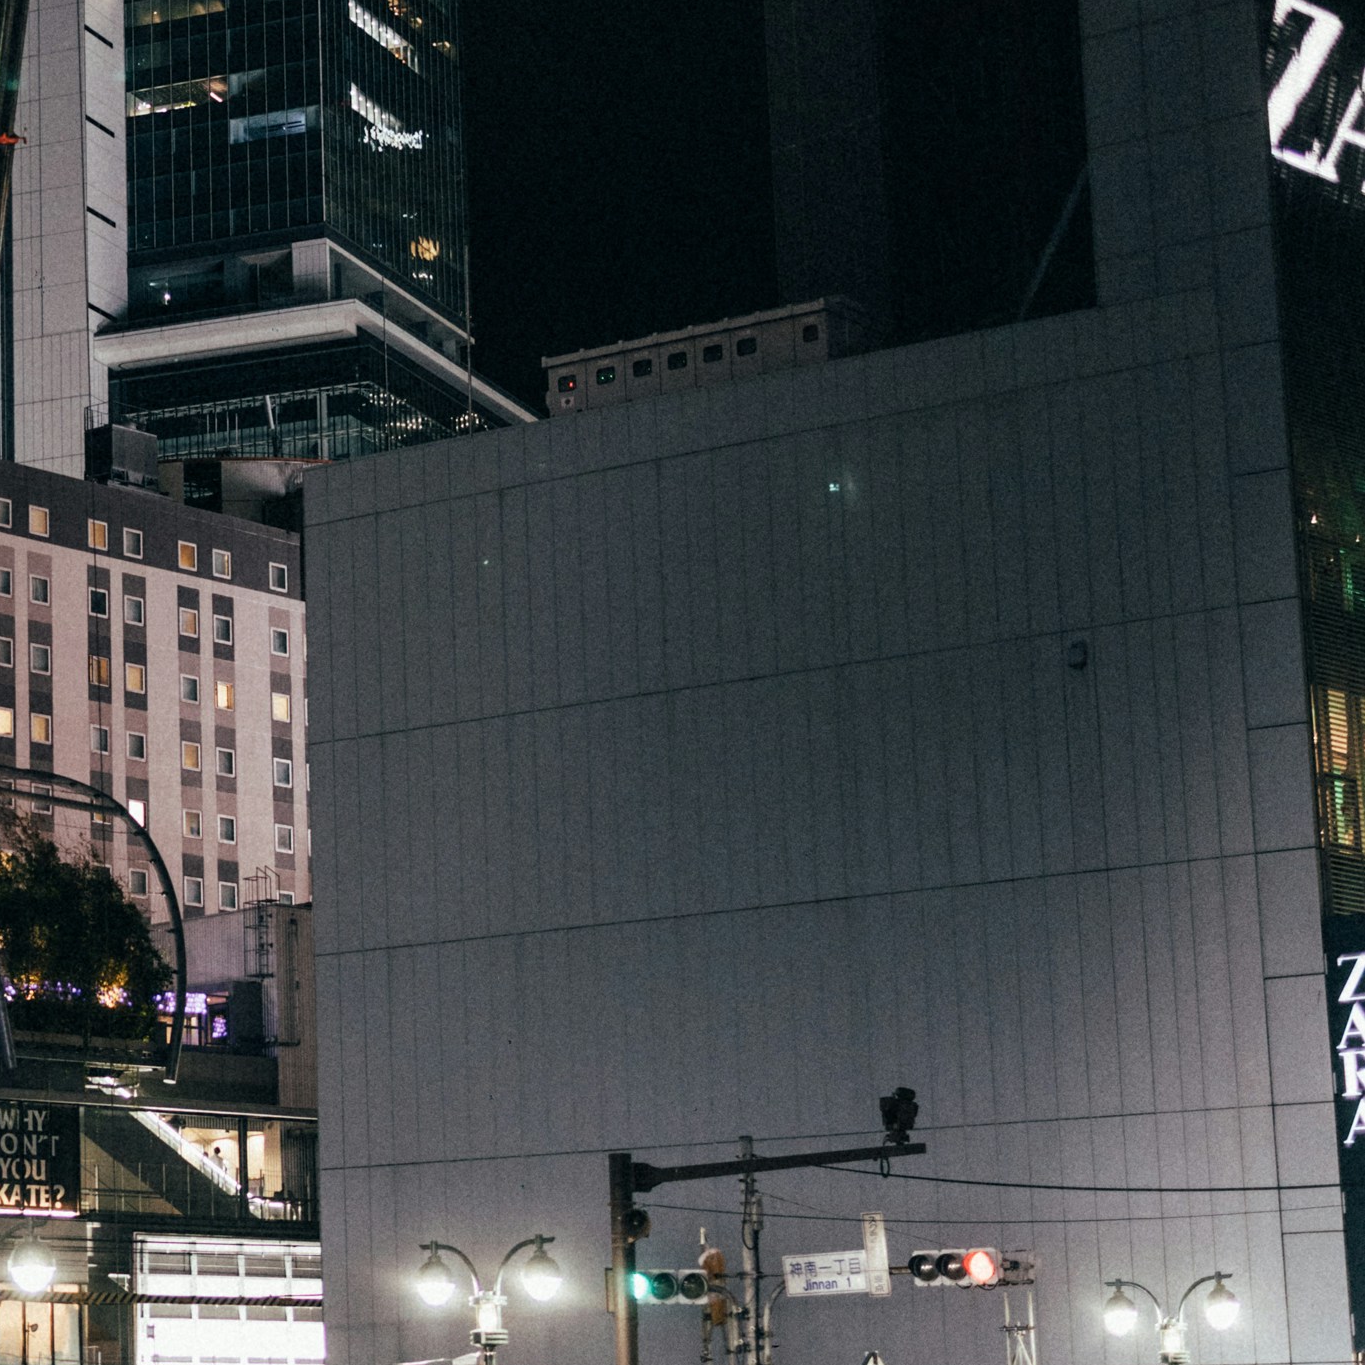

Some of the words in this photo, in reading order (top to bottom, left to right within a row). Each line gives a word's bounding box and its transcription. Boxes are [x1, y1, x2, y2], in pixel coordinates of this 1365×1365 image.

[789, 1257, 862, 1278] 神南一丁目
[803, 1278, 839, 1292] Jinnan
[846, 1277, 852, 1288] 1
